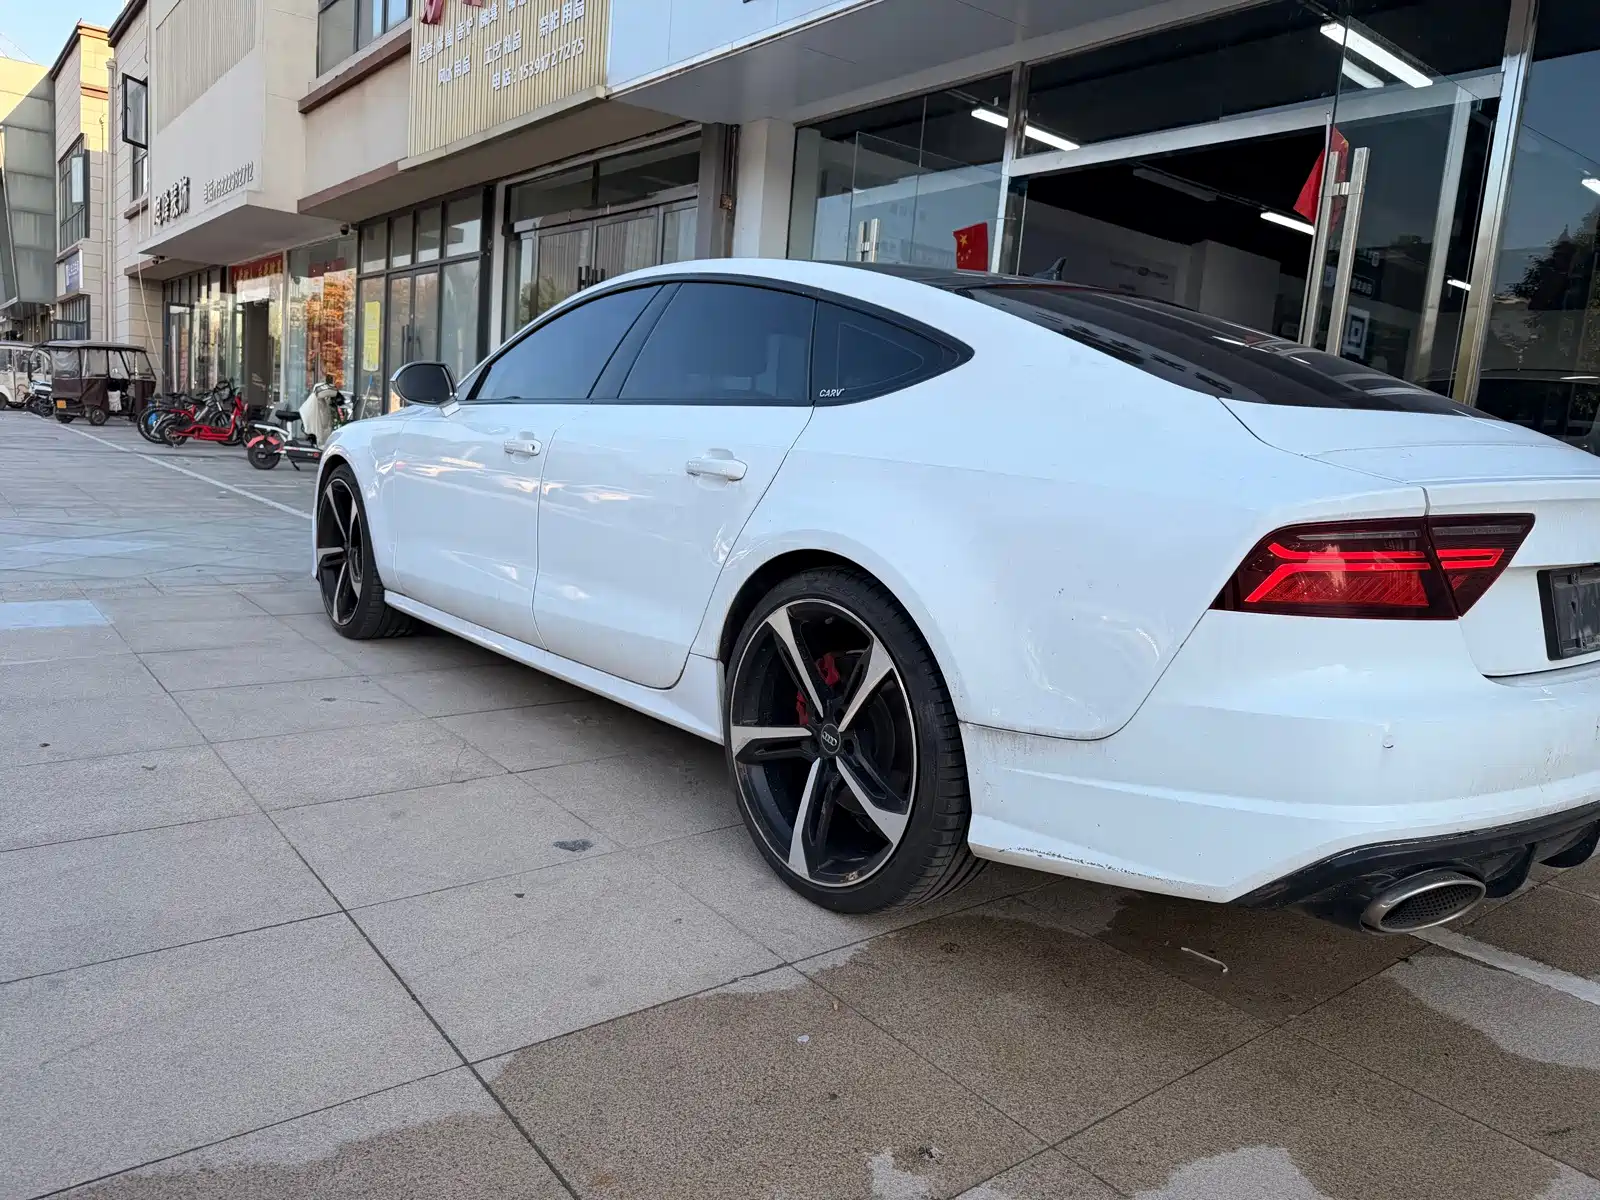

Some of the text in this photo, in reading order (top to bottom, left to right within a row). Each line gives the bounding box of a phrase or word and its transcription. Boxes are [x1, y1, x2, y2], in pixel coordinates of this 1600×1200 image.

[484, 30, 522, 65] 工艺礼品
[539, 0, 584, 38] 祭祀用品
